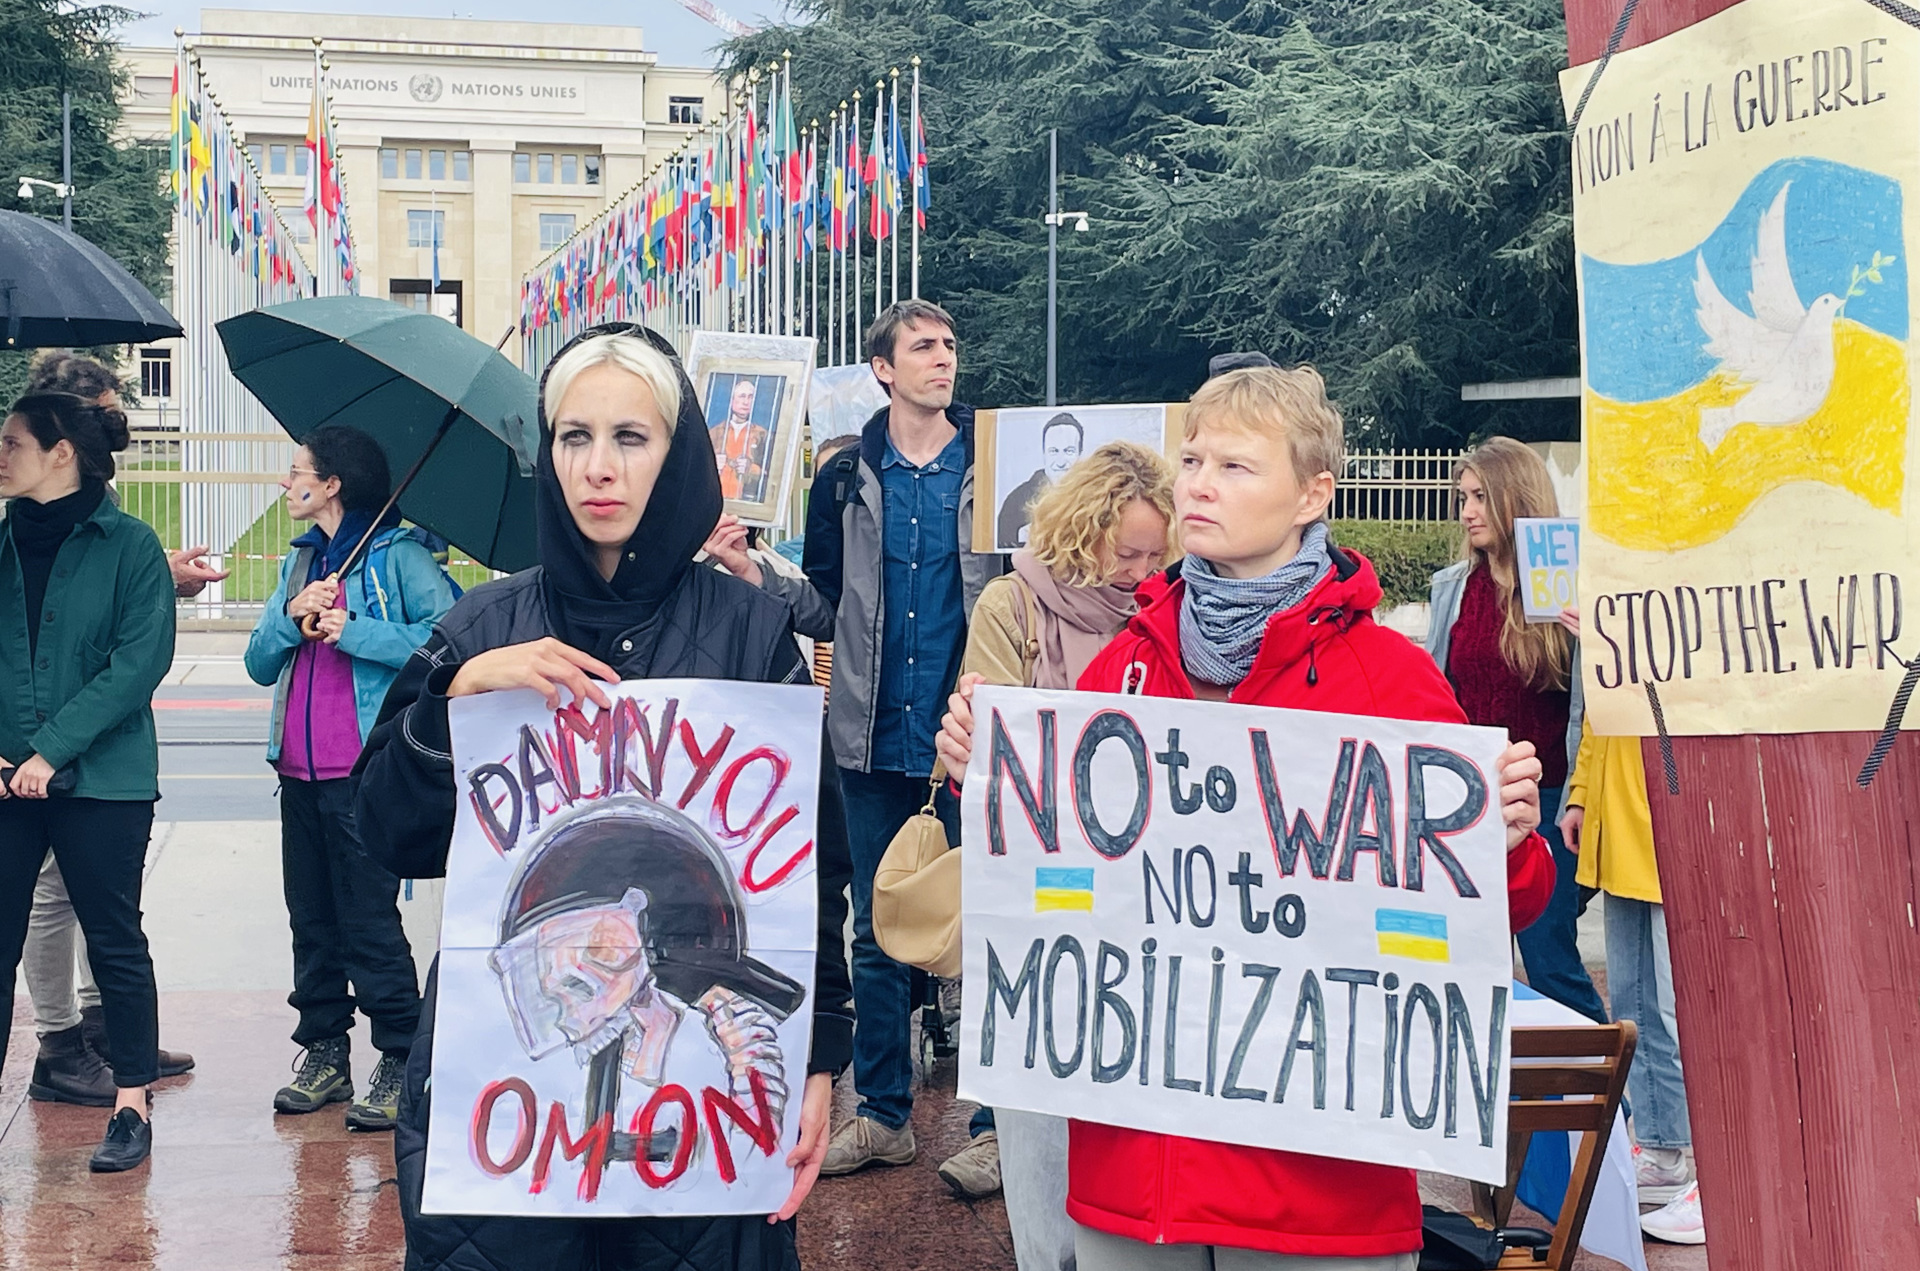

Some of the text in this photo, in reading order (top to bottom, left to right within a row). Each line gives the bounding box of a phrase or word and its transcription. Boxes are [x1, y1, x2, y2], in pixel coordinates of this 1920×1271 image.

[270, 76, 399, 92] UNITE NATIONS
[452, 83, 577, 99] NATIONS UNIES
[1575, 112, 1635, 195] NON
[1685, 83, 1720, 152] LA
[1733, 38, 1887, 133] GUERRE
[1530, 569, 1580, 610] ВО
[1594, 572, 1912, 689] STOP THE WAR
[677, 717, 814, 894] YOU
[985, 707, 1489, 899] NO to WAR
[1143, 844, 1307, 938] NO to
[468, 1066, 777, 1202] OMON
